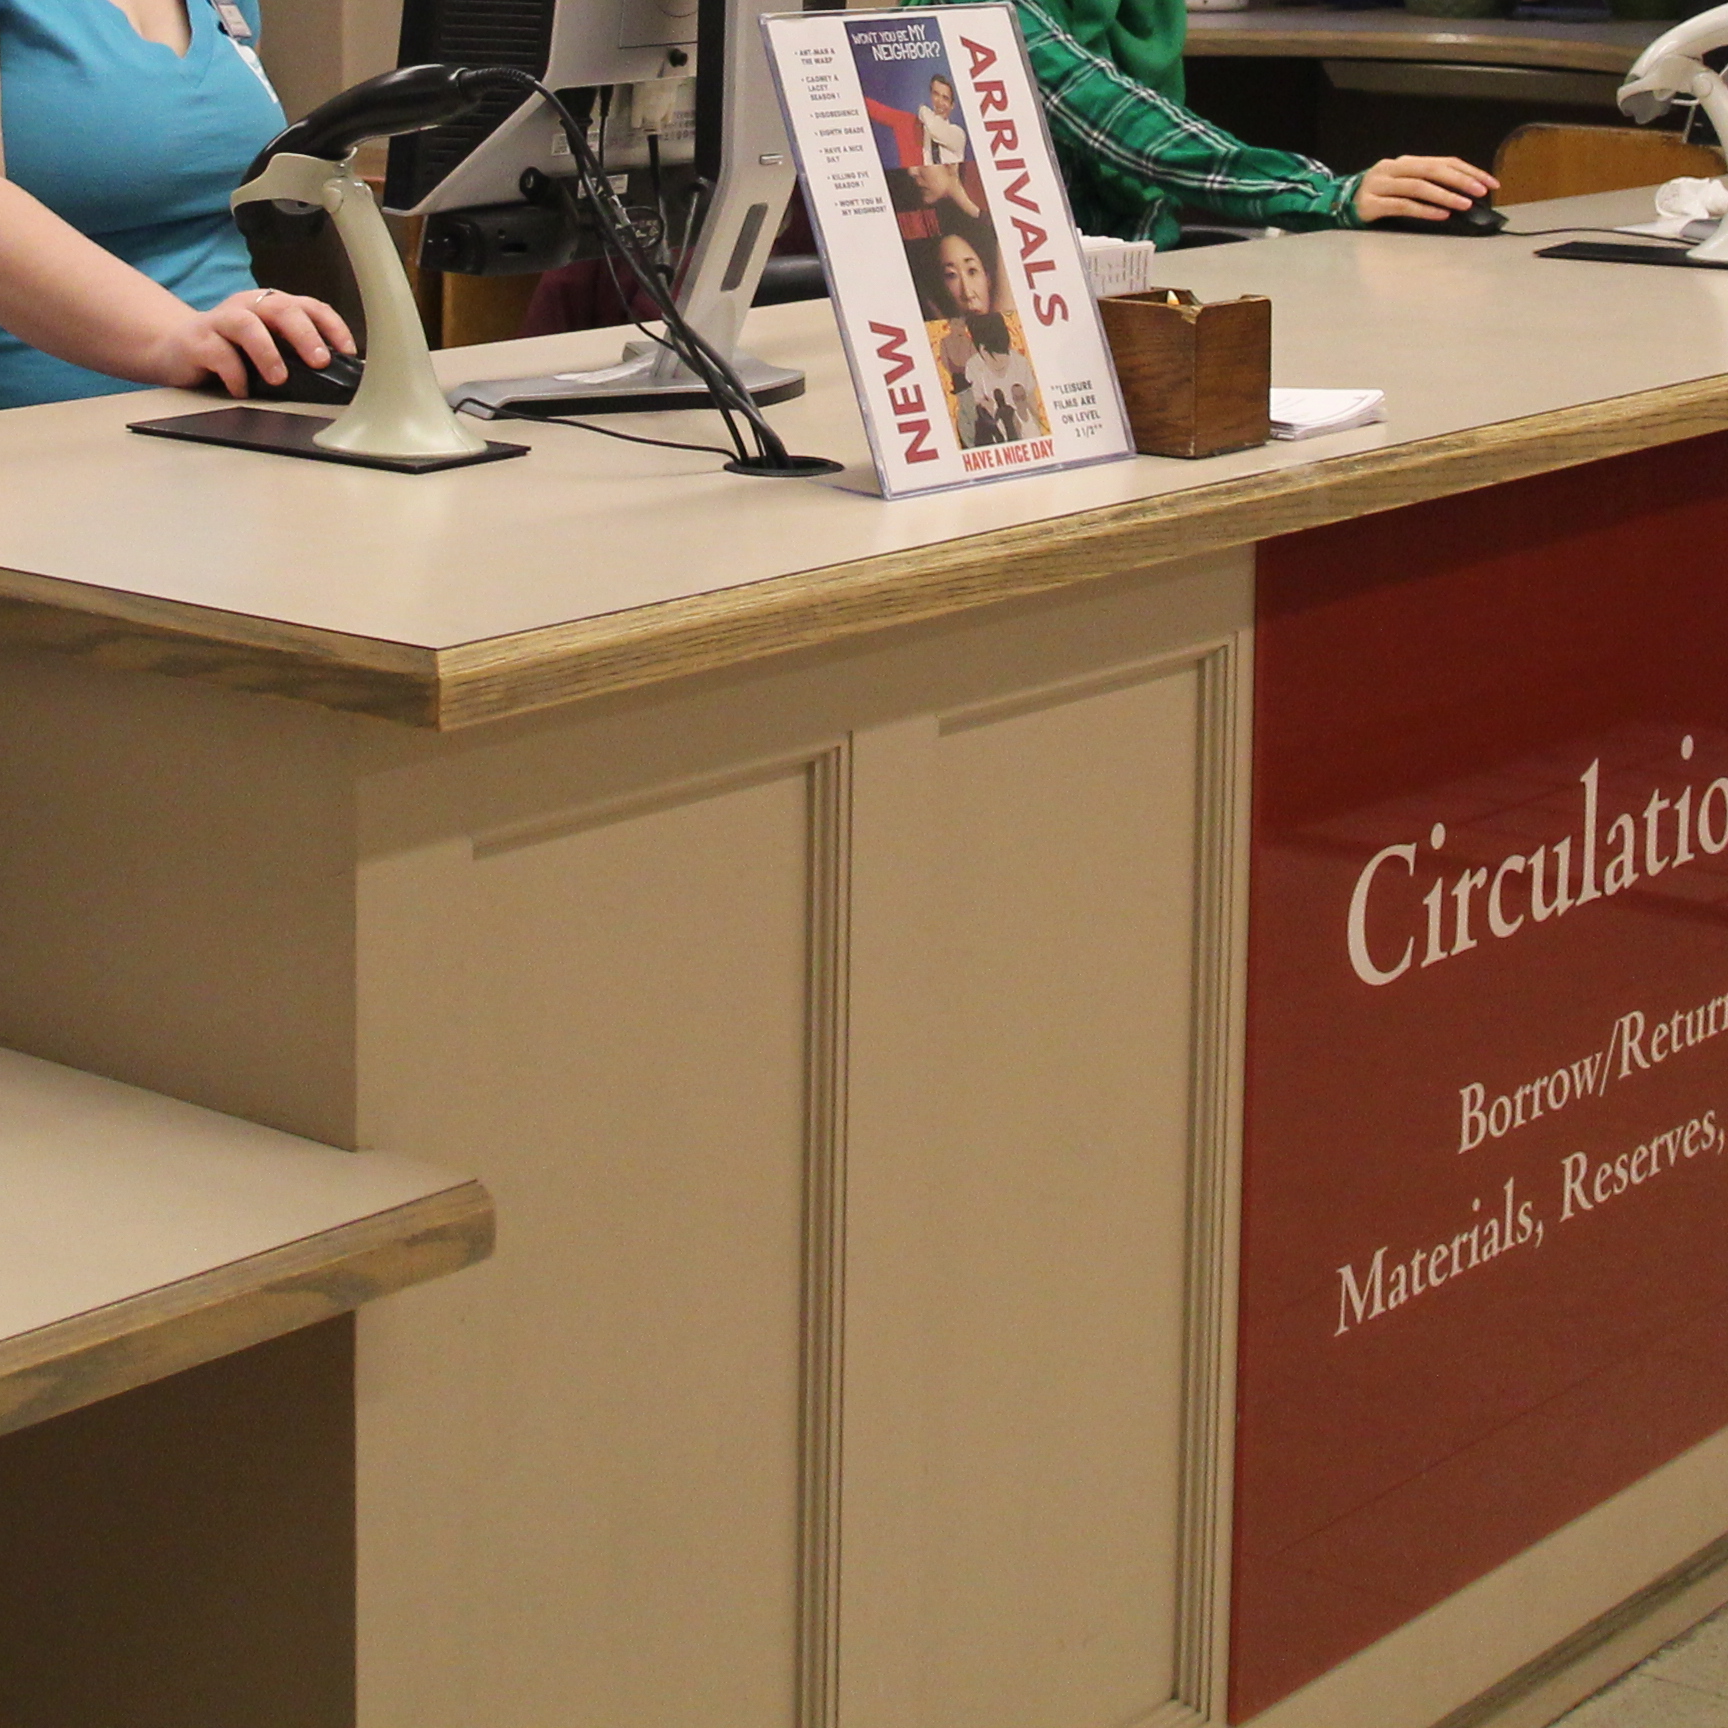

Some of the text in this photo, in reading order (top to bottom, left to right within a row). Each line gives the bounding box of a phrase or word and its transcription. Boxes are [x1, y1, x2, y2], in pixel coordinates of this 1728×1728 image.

[880, 30, 896, 43] YOU
[897, 30, 908, 42] BE
[907, 24, 926, 41] MY
[872, 41, 940, 61] NEIGHBOR?
[801, 58, 813, 66] THE
[808, 84, 829, 92] LACEY
[810, 93, 837, 101] SEASON
[815, 109, 859, 119] DISOBEDIENCE
[819, 127, 865, 136] EIGHTH GRADE
[824, 146, 842, 154] HAVE
[849, 144, 864, 152] NICE
[826, 155, 840, 163] DAY
[832, 171, 870, 181] KILLING EVE
[959, 35, 1070, 327] ARRIVALS
[834, 182, 860, 190] SEASON
[861, 197, 875, 206] YOU
[841, 205, 887, 217] MY NEIGHBOR?
[868, 320, 940, 465] NEW
[1053, 395, 1097, 411] FILMS ARE
[1062, 410, 1101, 425] ON LEVEL
[962, 439, 1056, 473] HAVE A NICE DAY
[1333, 1180, 1544, 1337] Materials,
[1560, 1106, 1725, 1226] Reserves,
